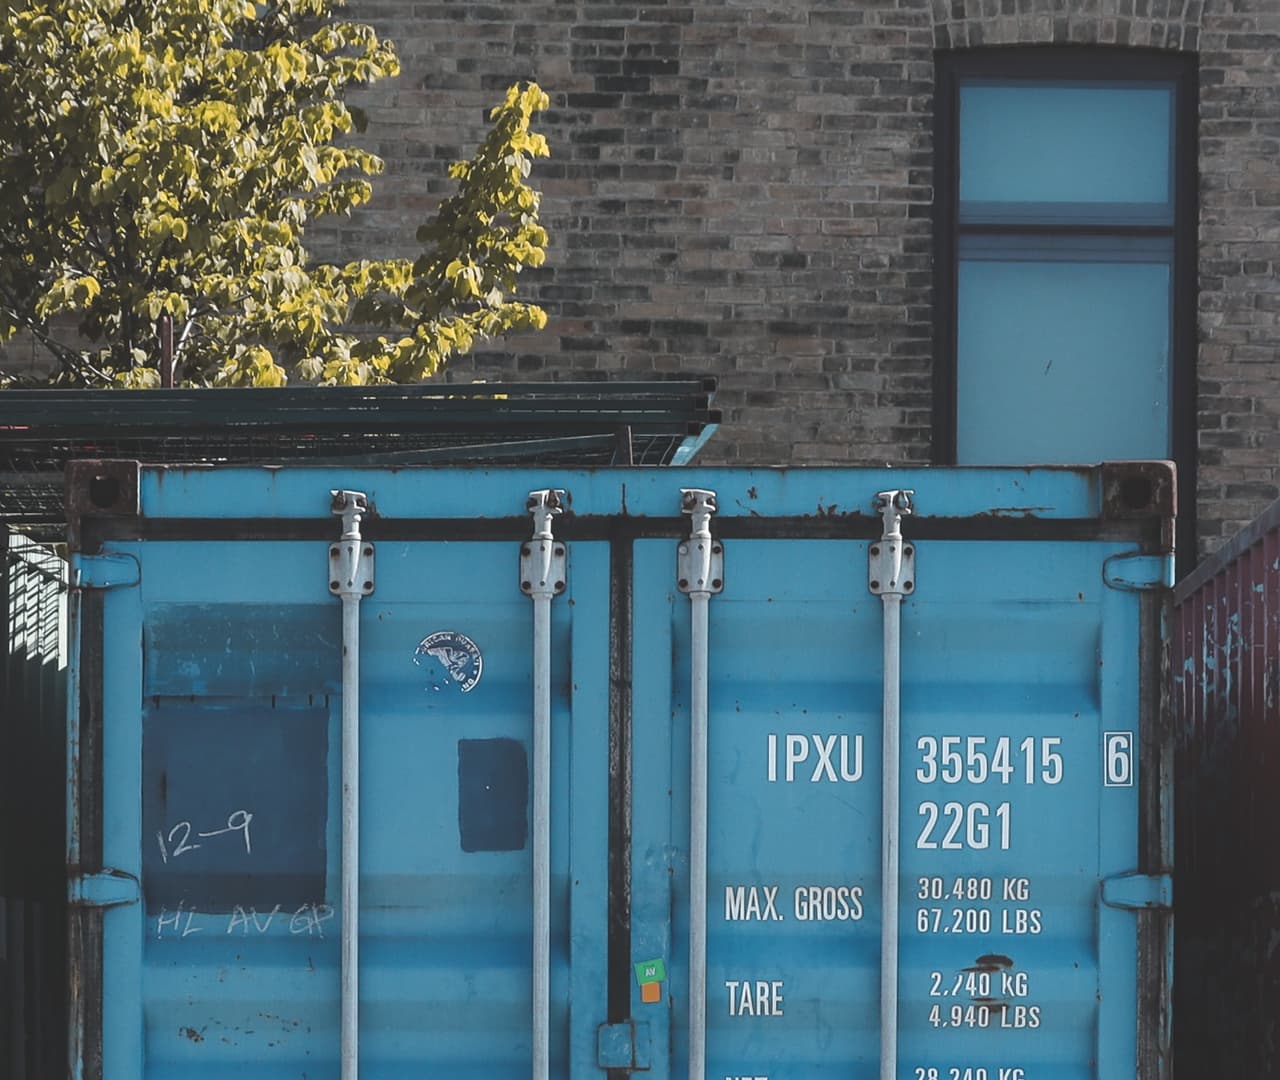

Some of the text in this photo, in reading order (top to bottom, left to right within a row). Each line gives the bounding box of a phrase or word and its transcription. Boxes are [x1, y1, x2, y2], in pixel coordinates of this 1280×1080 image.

[767, 734, 1130, 785] IPXU 355415 6
[916, 801, 1011, 850] 22G1
[725, 886, 785, 922] MAX.
[794, 886, 864, 922] GROSS
[1002, 877, 1030, 901] KG
[1001, 909, 1042, 935] LBS
[725, 980, 784, 1016] TARE
[1001, 972, 1028, 997] KG
[1000, 1005, 1041, 1028] LBS
